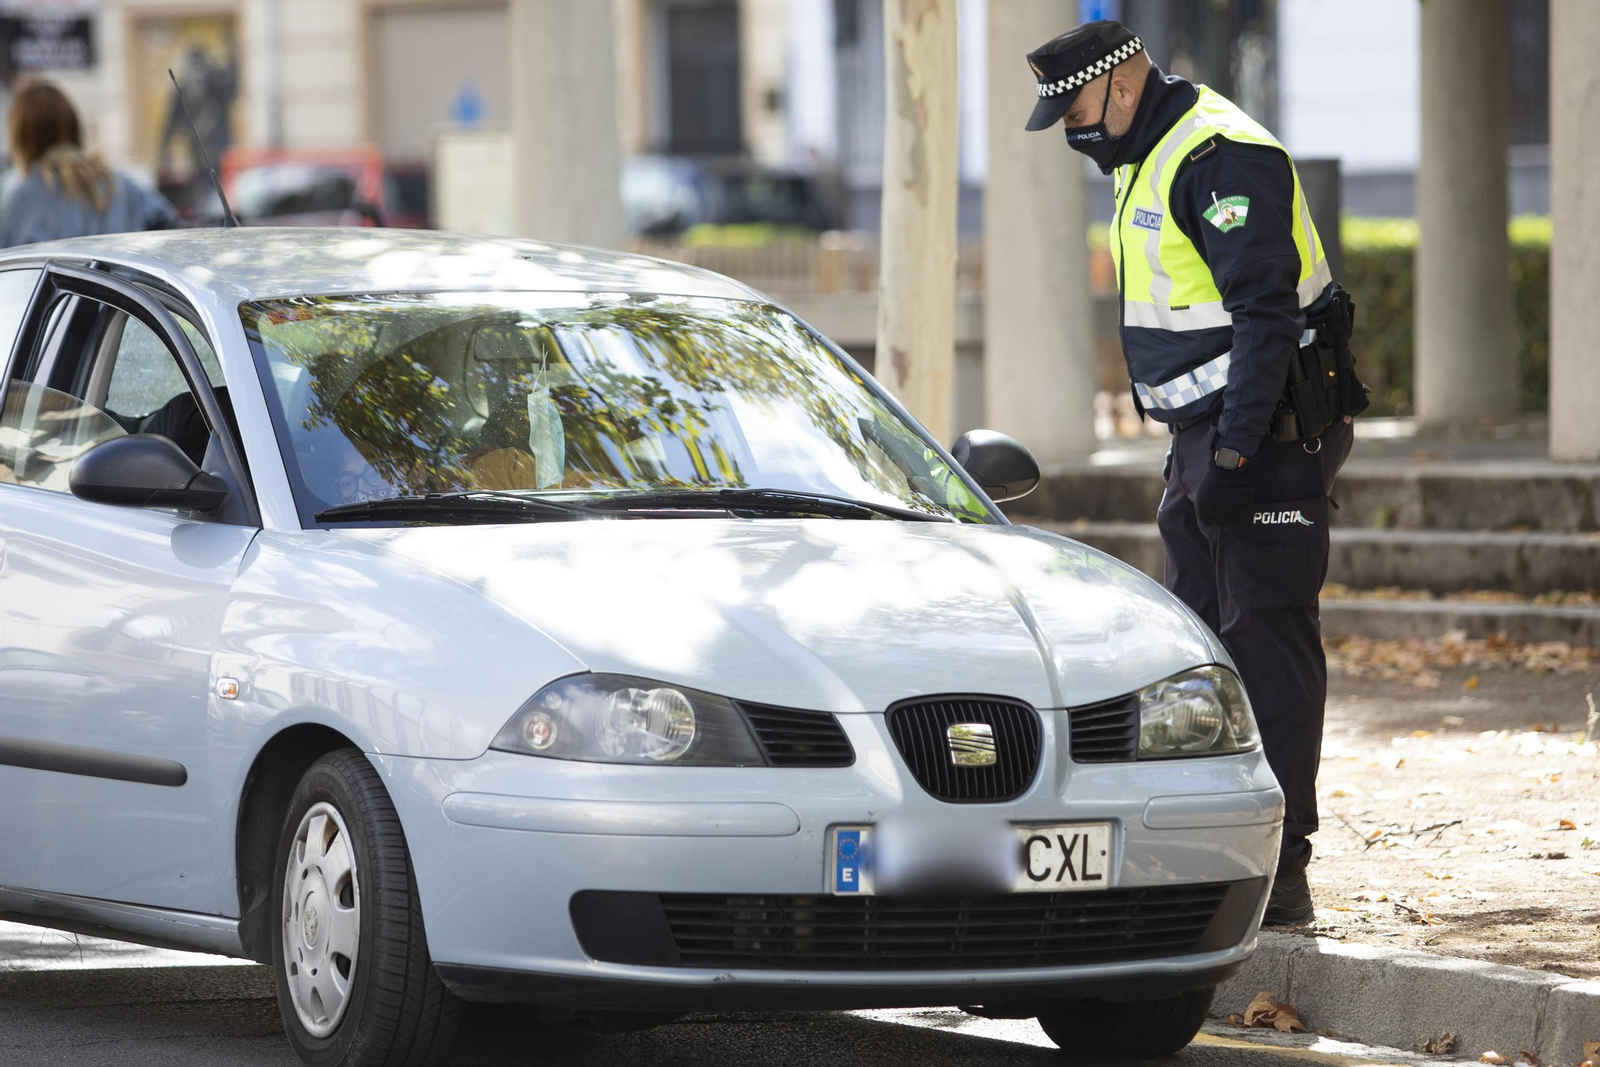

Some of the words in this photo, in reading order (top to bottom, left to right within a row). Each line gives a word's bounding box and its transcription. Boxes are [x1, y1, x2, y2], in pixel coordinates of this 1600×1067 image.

[1078, 131, 1101, 140] POLICIA
[1135, 210, 1162, 228] POLICIA
[1253, 510, 1301, 524] POLICIA
[842, 867, 853, 882] E
[1025, 834, 1102, 882] CXL
